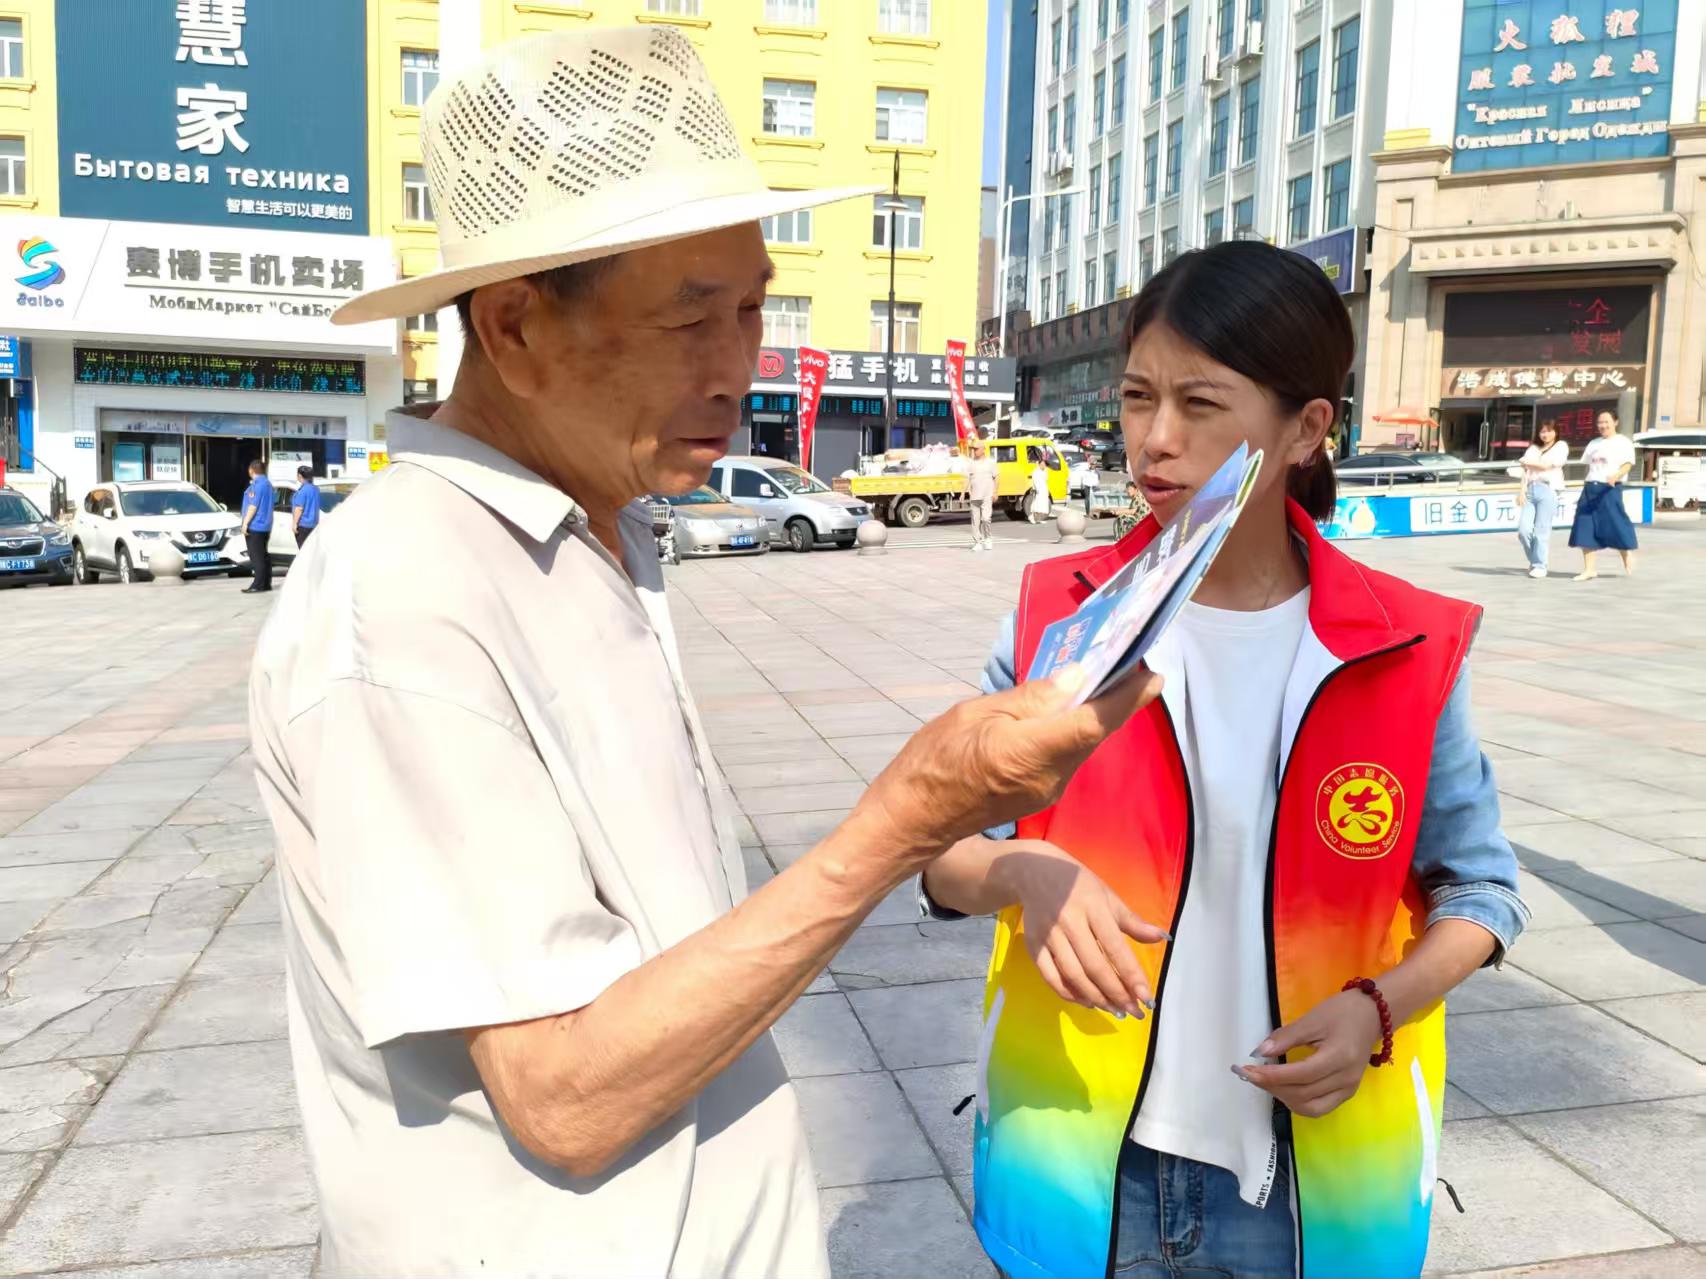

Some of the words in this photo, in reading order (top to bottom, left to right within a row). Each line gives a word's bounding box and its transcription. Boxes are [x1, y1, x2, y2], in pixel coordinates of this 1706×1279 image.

[175, 0, 250, 155] 慧家
[1535, 125, 1590, 145] Город
[74, 152, 210, 185] Бытовая
[225, 165, 351, 195] техника
[225, 197, 353, 222] 智慧生活可以更美的
[125, 245, 366, 292] 赛博手机卖场
[149, 294, 265, 316] МобиМаркет
[793, 353, 920, 385] 猛手机
[802, 354, 825, 367] vivo
[1322, 767, 1400, 797] 中国志愿服务
[1321, 819, 1339, 844] China
[1340, 842, 1380, 854] Volunteer
[1381, 820, 1401, 848] Service
[1255, 1183, 1270, 1207] PORTS
[1267, 1142, 1277, 1172] FASHION
